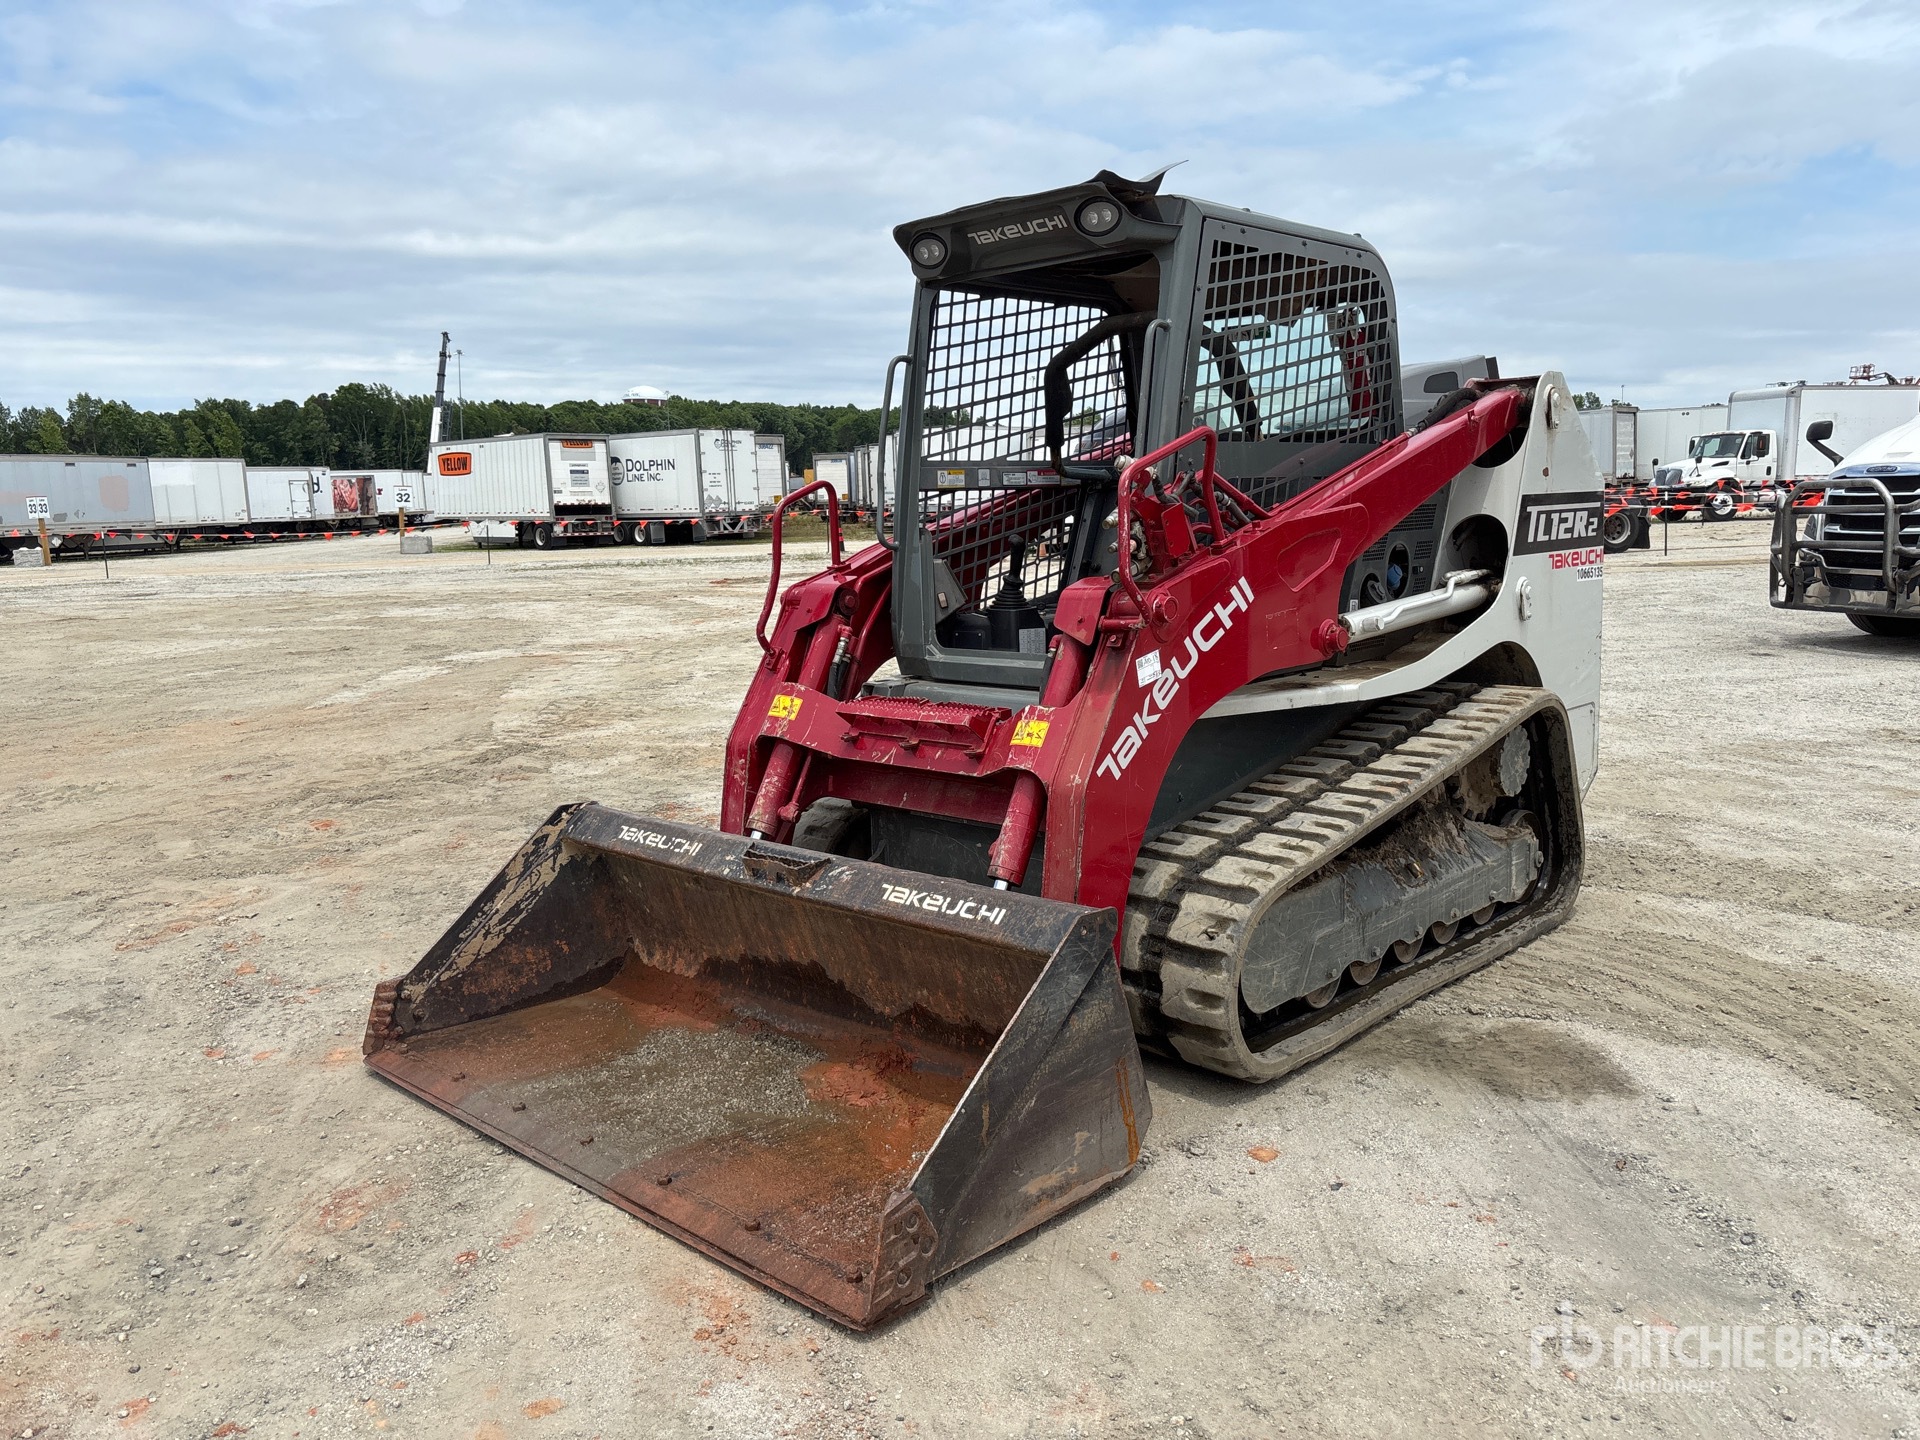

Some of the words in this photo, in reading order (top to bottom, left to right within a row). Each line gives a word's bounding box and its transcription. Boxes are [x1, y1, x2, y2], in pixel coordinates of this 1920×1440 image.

[967, 214, 1068, 245] TAKEUCHI
[441, 456, 468, 471] YELLOW
[625, 458, 676, 472] DOLPHIN
[626, 472, 646, 482] LINE
[646, 471, 664, 482] INC.
[395, 492, 411, 503] 32
[28, 503, 37, 514] 33
[38, 503, 48, 514] 33
[1577, 566, 1603, 579] 10665135
[1096, 575, 1255, 781] TAKEUCHI
[881, 883, 1007, 925] TAKEUCHI
